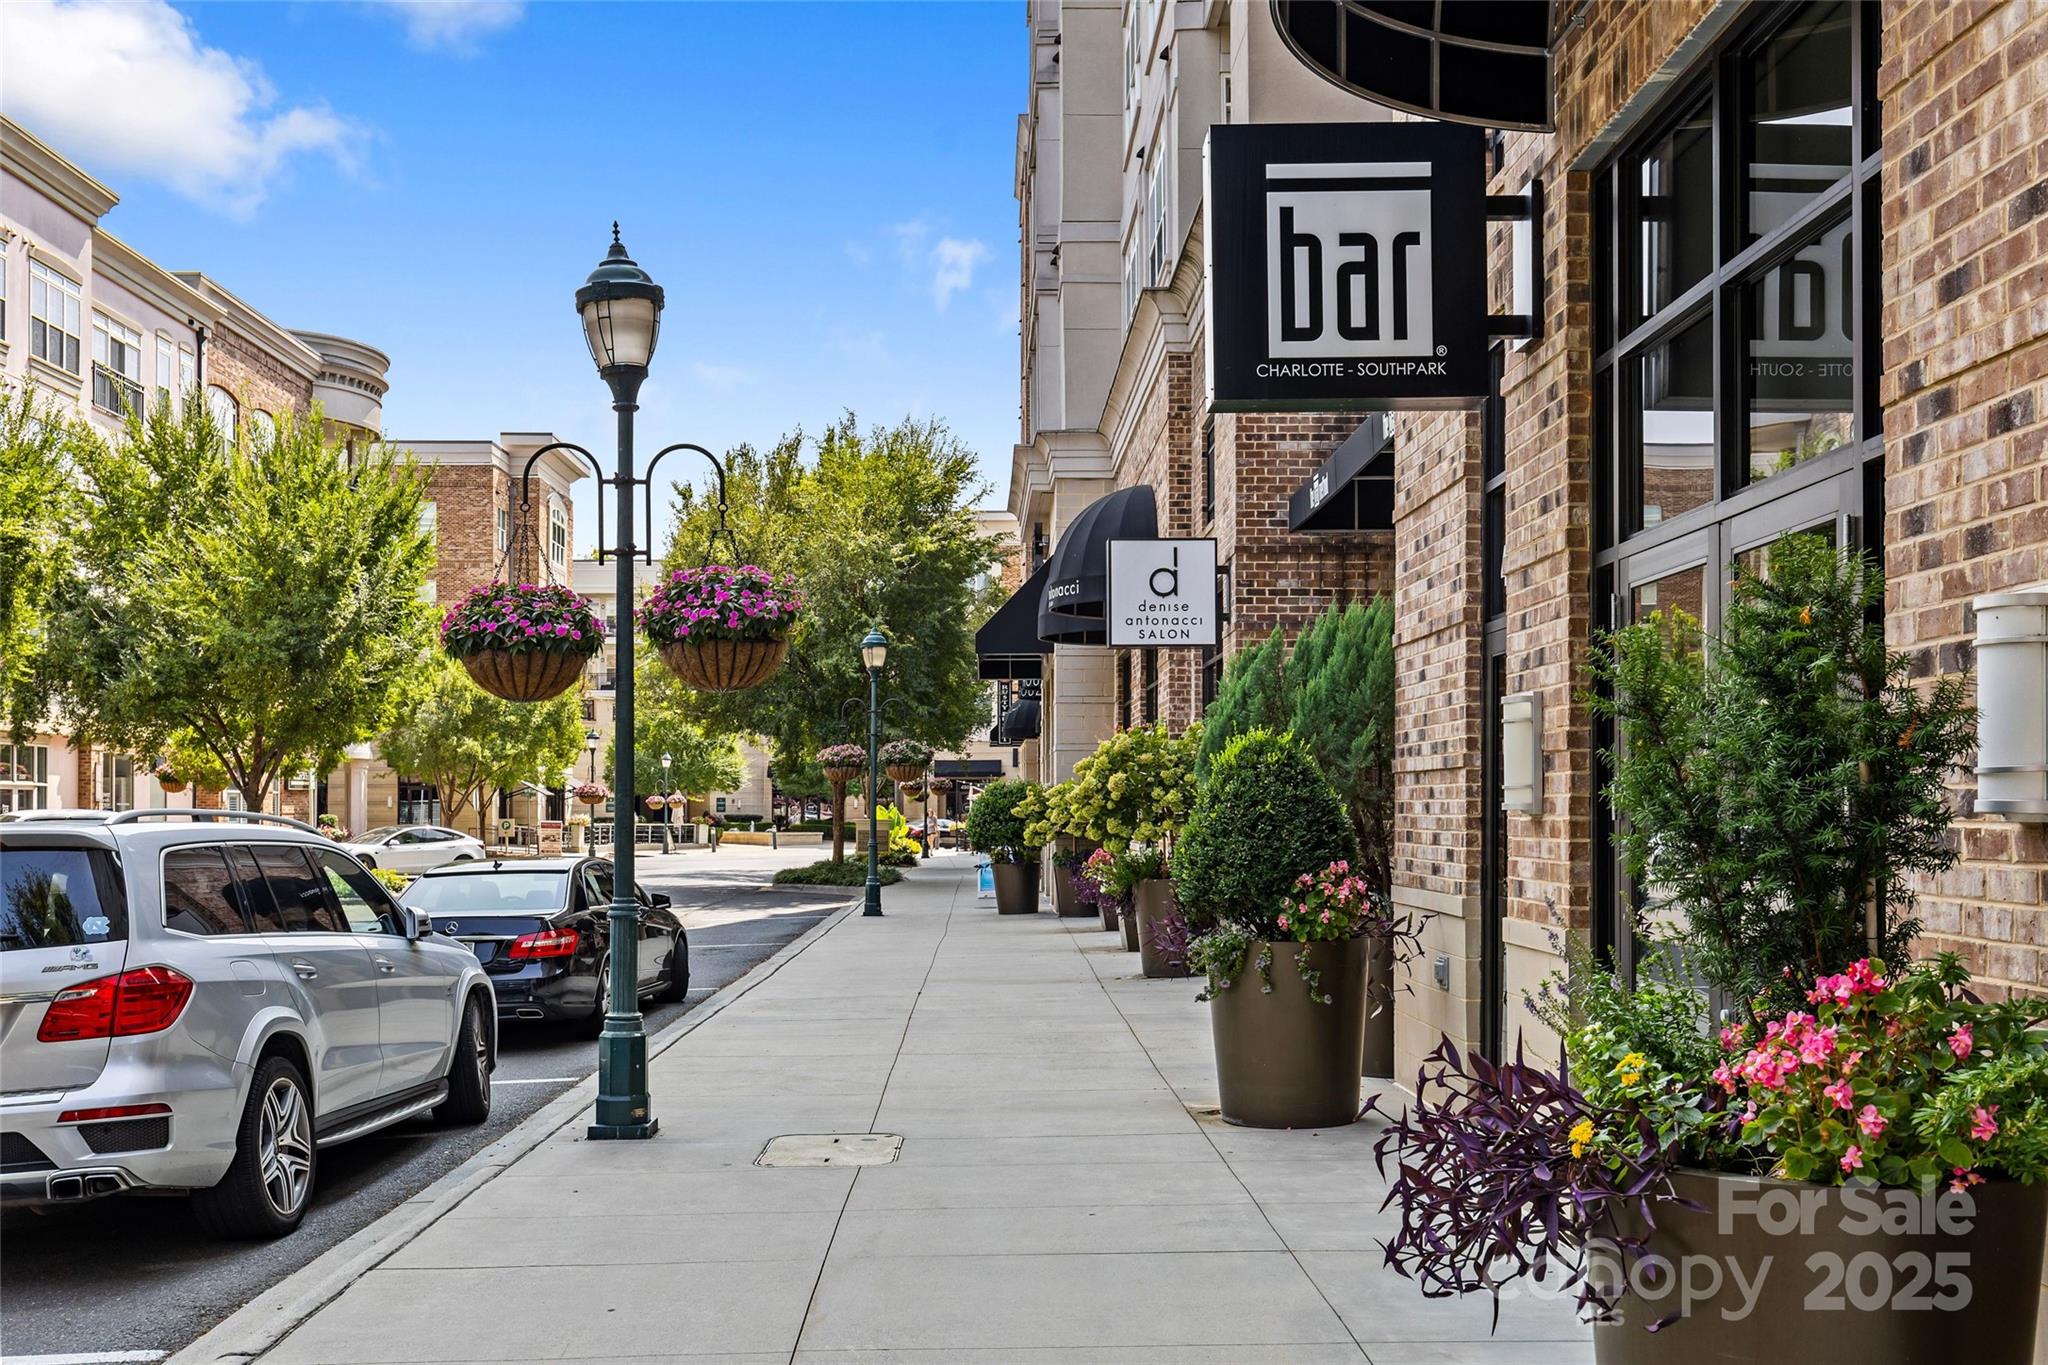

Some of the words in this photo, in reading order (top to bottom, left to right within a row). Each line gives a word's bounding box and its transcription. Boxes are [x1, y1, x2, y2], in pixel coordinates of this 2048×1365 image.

[1279, 206, 1421, 342] bar
[1256, 363, 1344, 378] CHARLOTTE
[1357, 362, 1447, 376] SOUTHPARK
[1149, 546, 1179, 599] d
[1138, 600, 1190, 612] denise
[1125, 615, 1203, 626] antonacci
[1138, 629, 1191, 639] SALON
